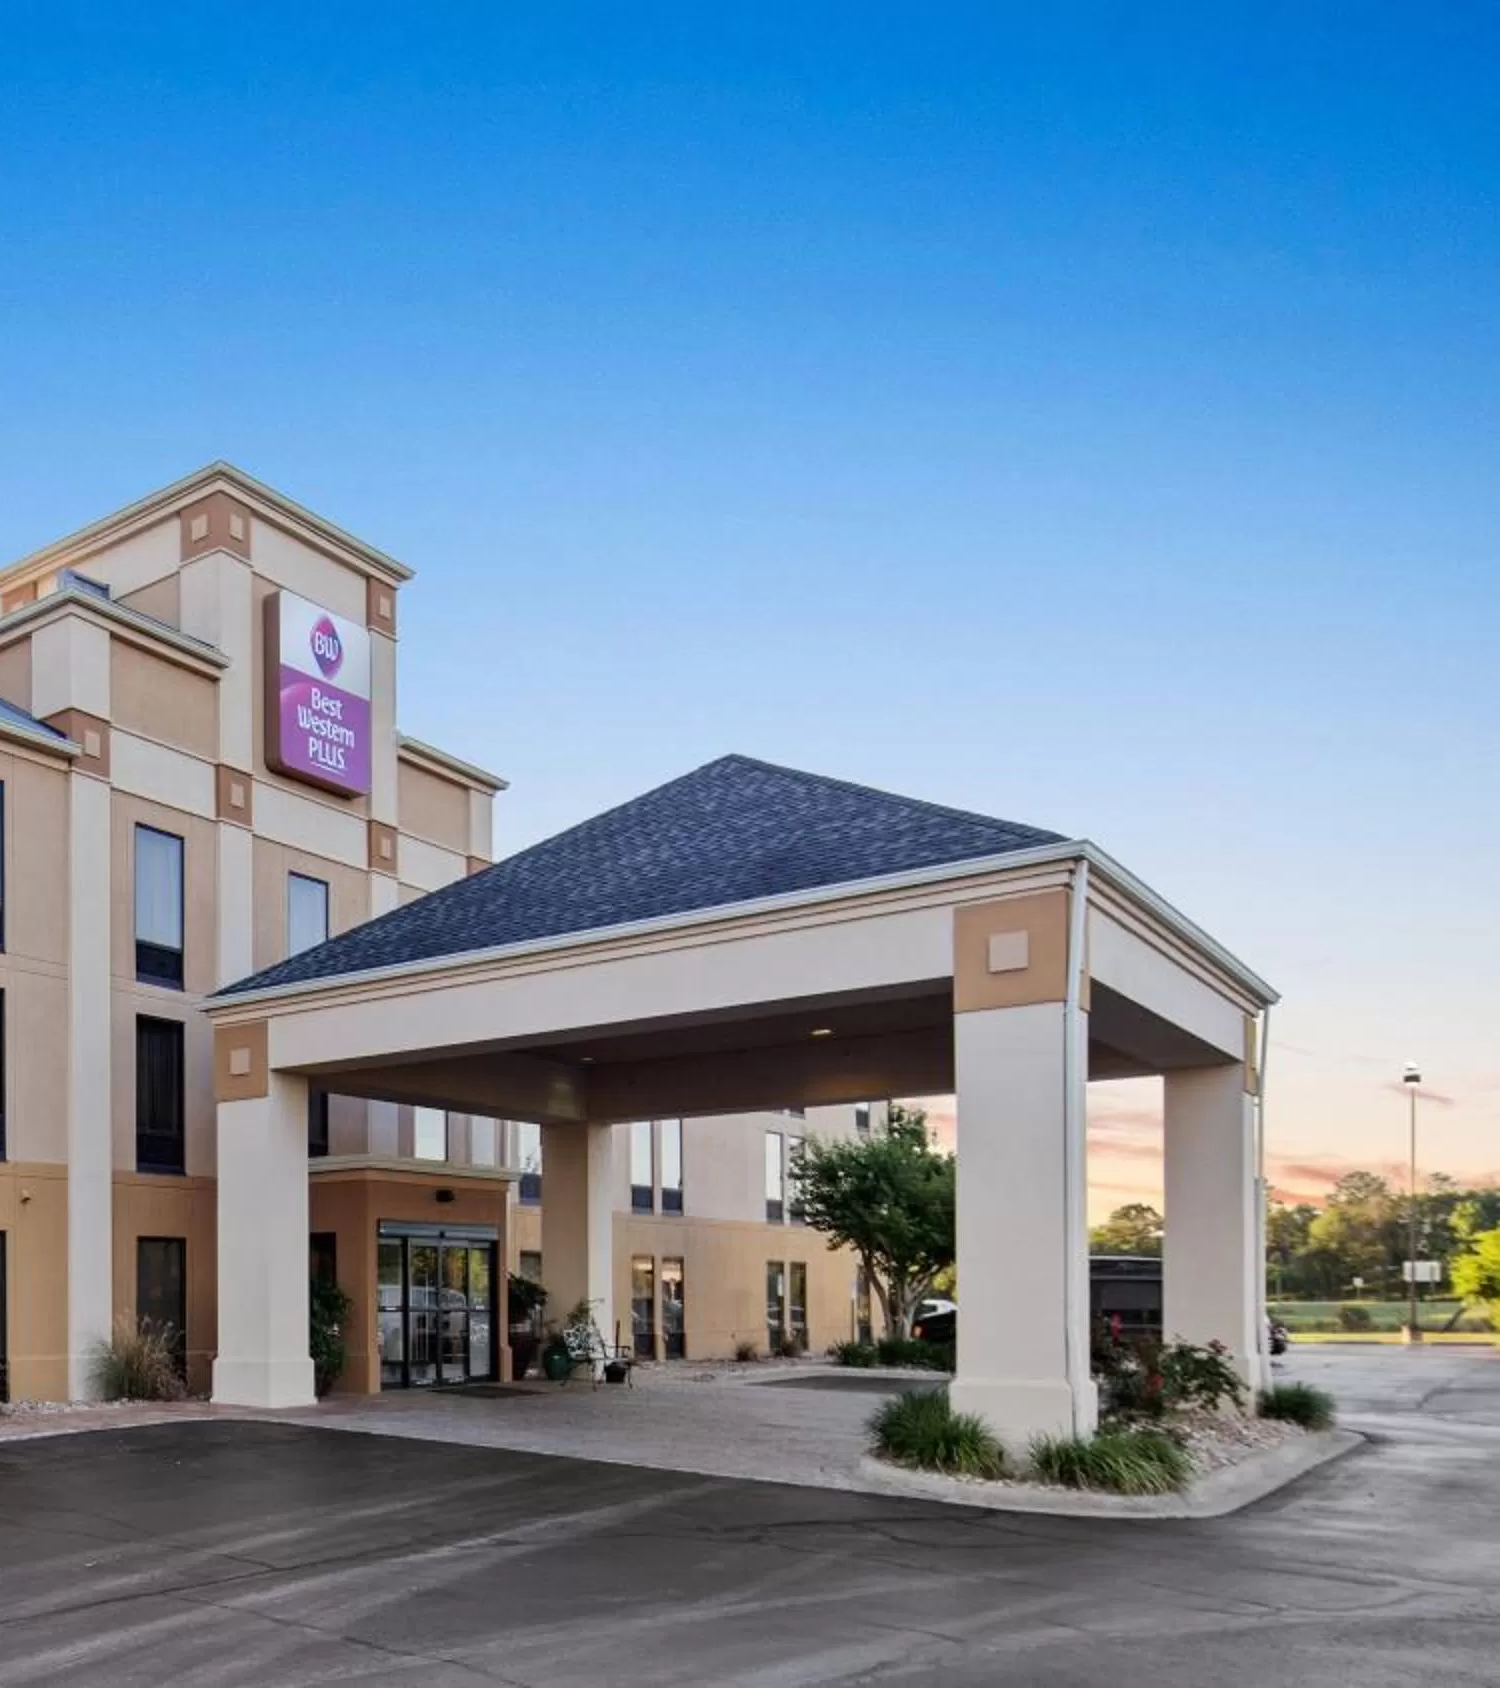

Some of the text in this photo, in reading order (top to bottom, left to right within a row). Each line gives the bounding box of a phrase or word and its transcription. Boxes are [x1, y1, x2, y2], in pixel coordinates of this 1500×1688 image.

[314, 631, 339, 661] BW
[311, 687, 343, 720] Best
[297, 704, 355, 749] Western
[308, 737, 345, 769] PLUS
